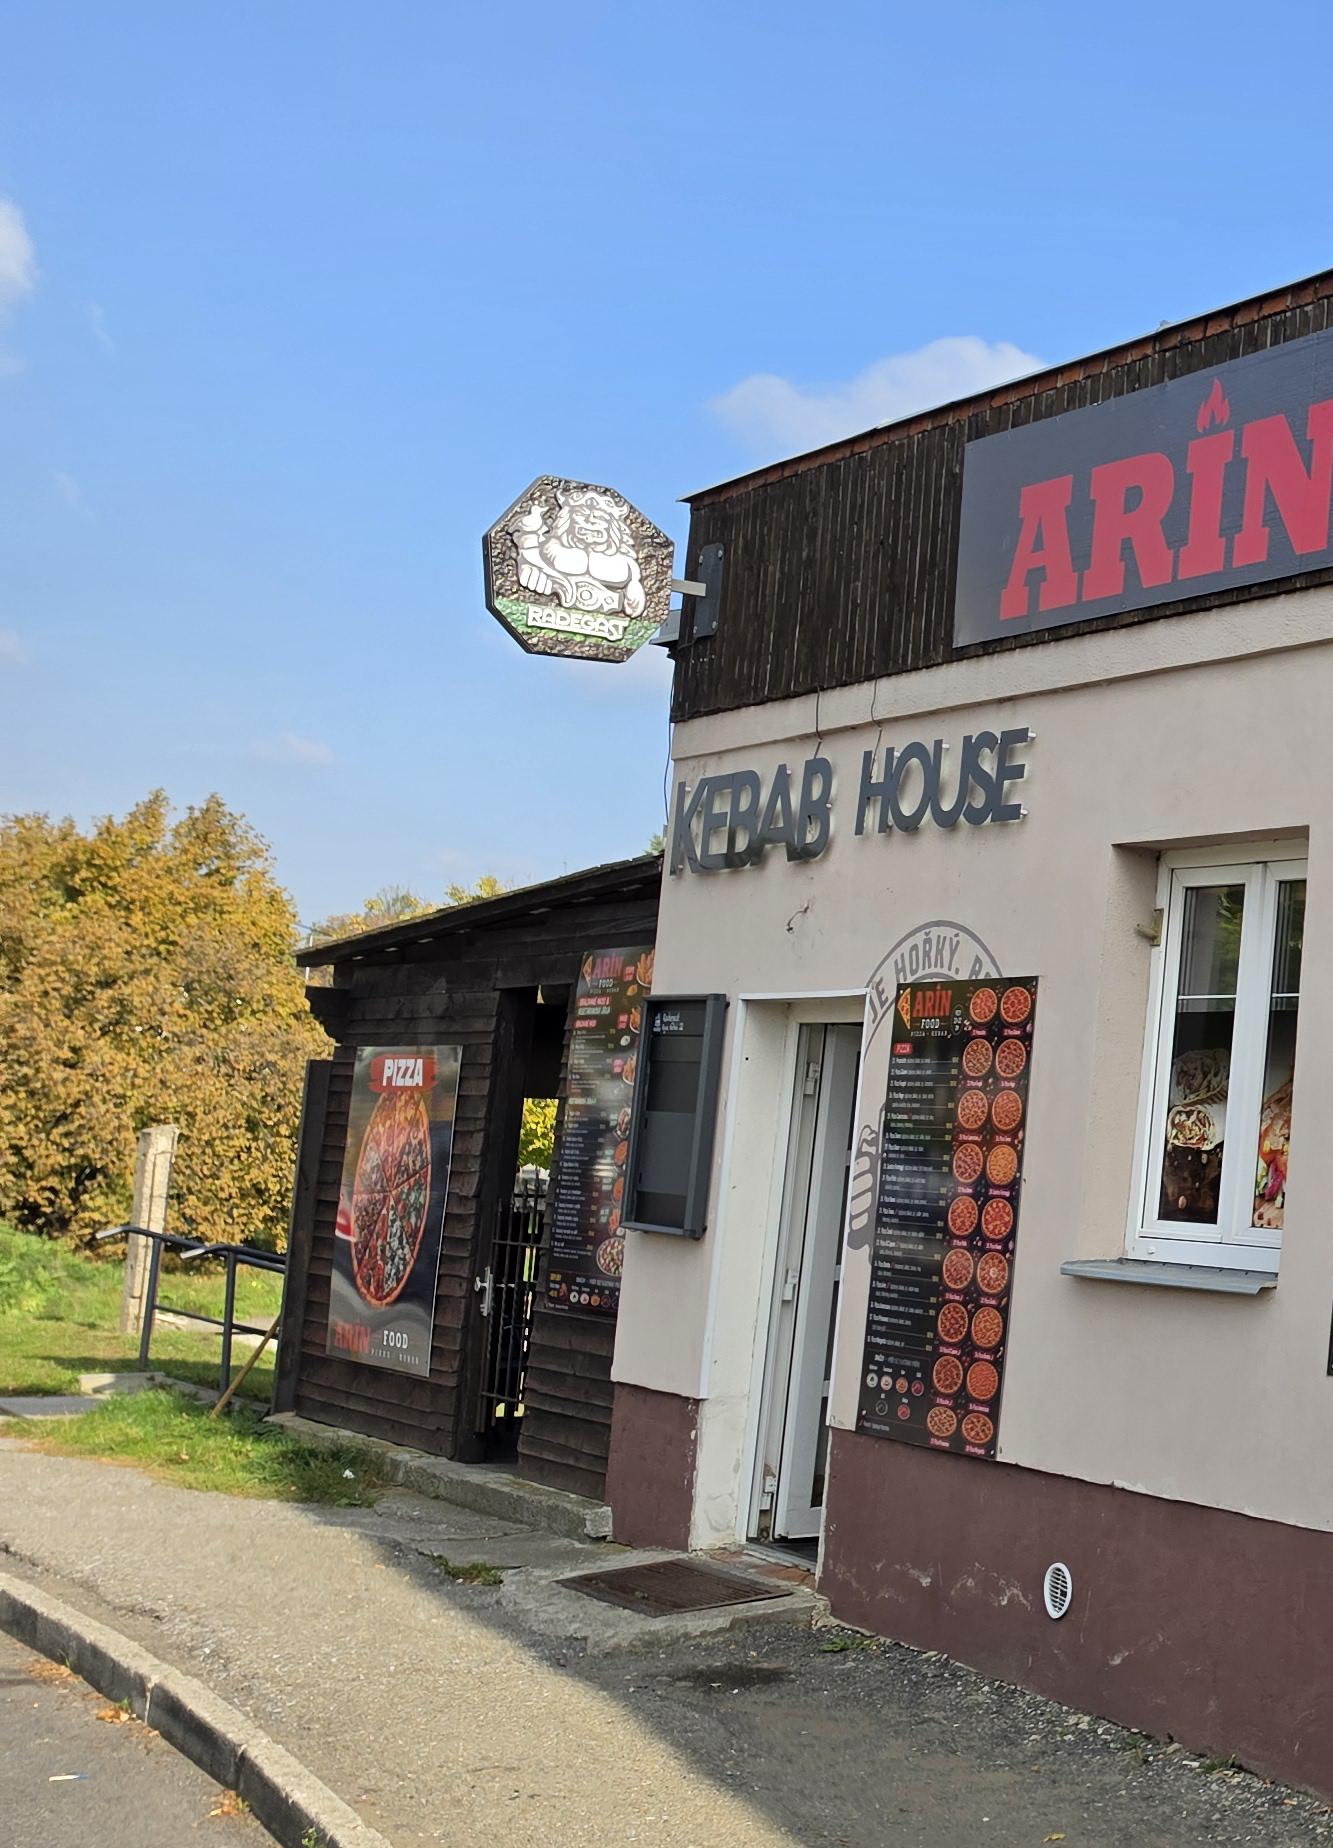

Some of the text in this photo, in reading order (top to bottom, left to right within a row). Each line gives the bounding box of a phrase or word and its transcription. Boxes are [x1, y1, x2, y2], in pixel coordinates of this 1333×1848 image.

[528, 606, 629, 637] RADEGAST
[669, 727, 1030, 876] KEBAB HOUSE
[920, 1018, 940, 1029] FOOD
[382, 1058, 423, 1087] PIZZA
[382, 1329, 409, 1349] FOOD
